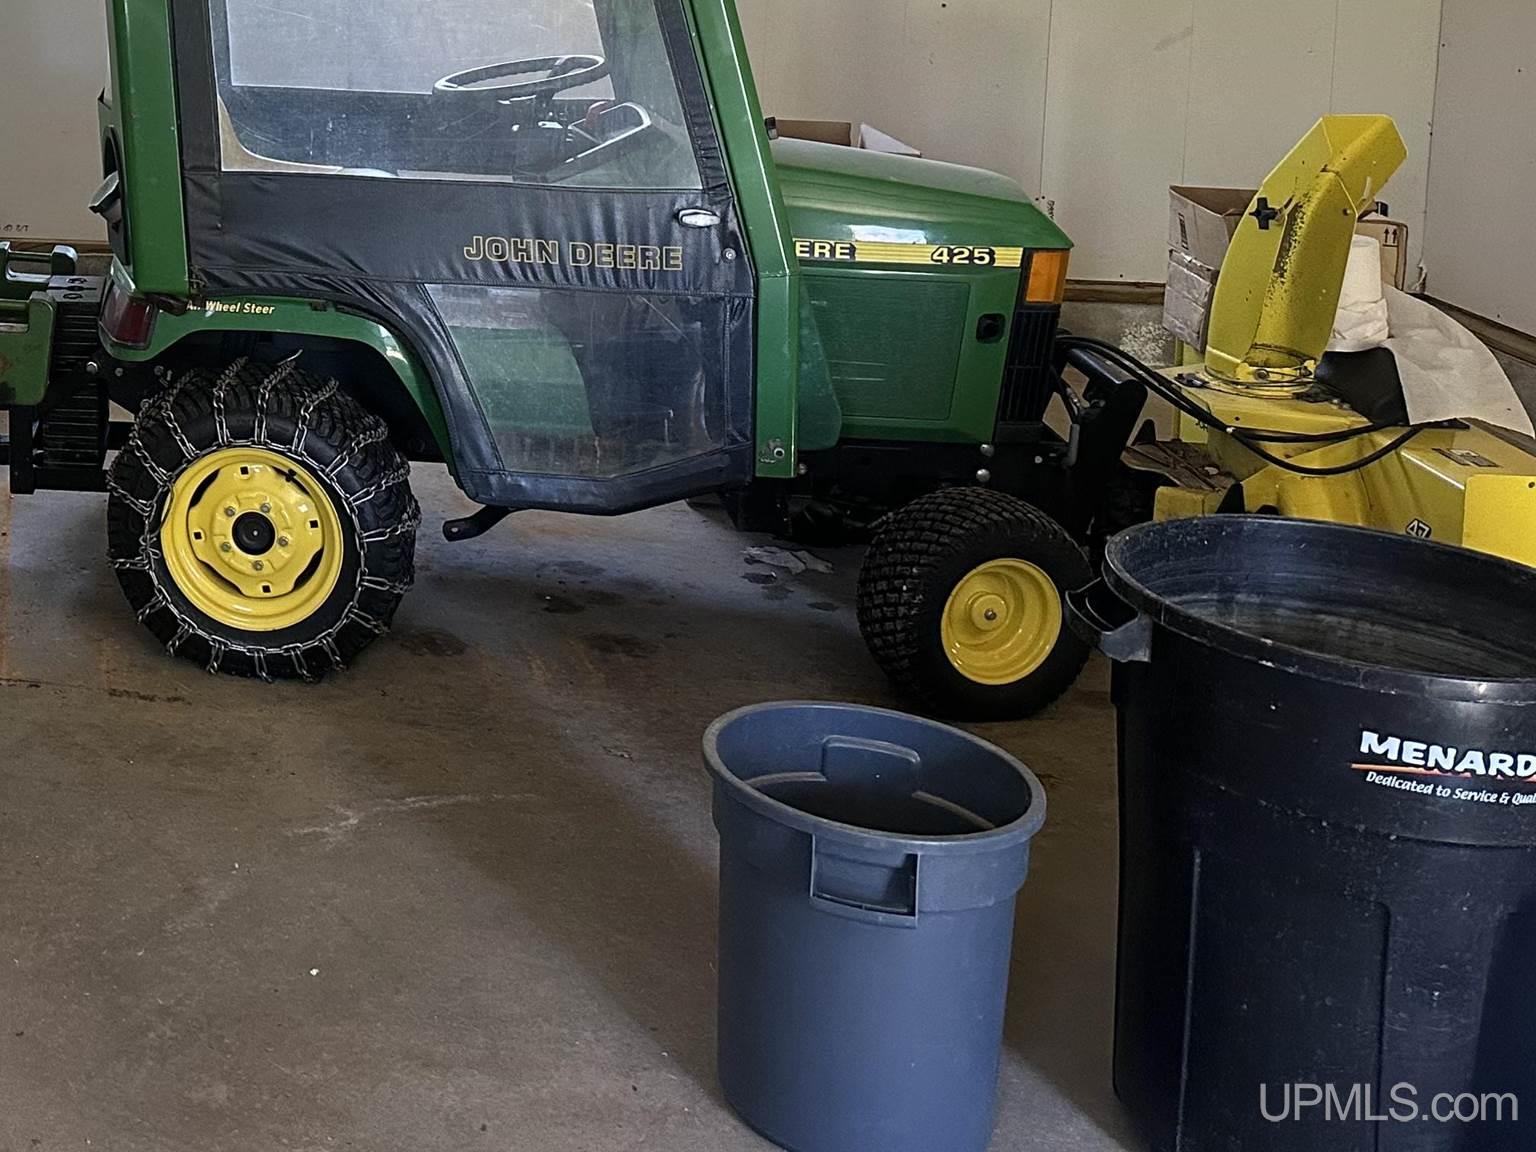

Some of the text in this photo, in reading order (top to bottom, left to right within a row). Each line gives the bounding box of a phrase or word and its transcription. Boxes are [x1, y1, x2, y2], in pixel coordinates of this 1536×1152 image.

[463, 236, 684, 271] JOHN DEERE
[932, 247, 993, 265] 425
[205, 300, 241, 313] Wheel
[243, 303, 276, 315] Steer
[1359, 730, 1536, 778] MENARD
[1365, 771, 1435, 795] Dedicated
[1435, 784, 1452, 798] to
[1452, 788, 1497, 803] Service
[1498, 792, 1511, 805] &
